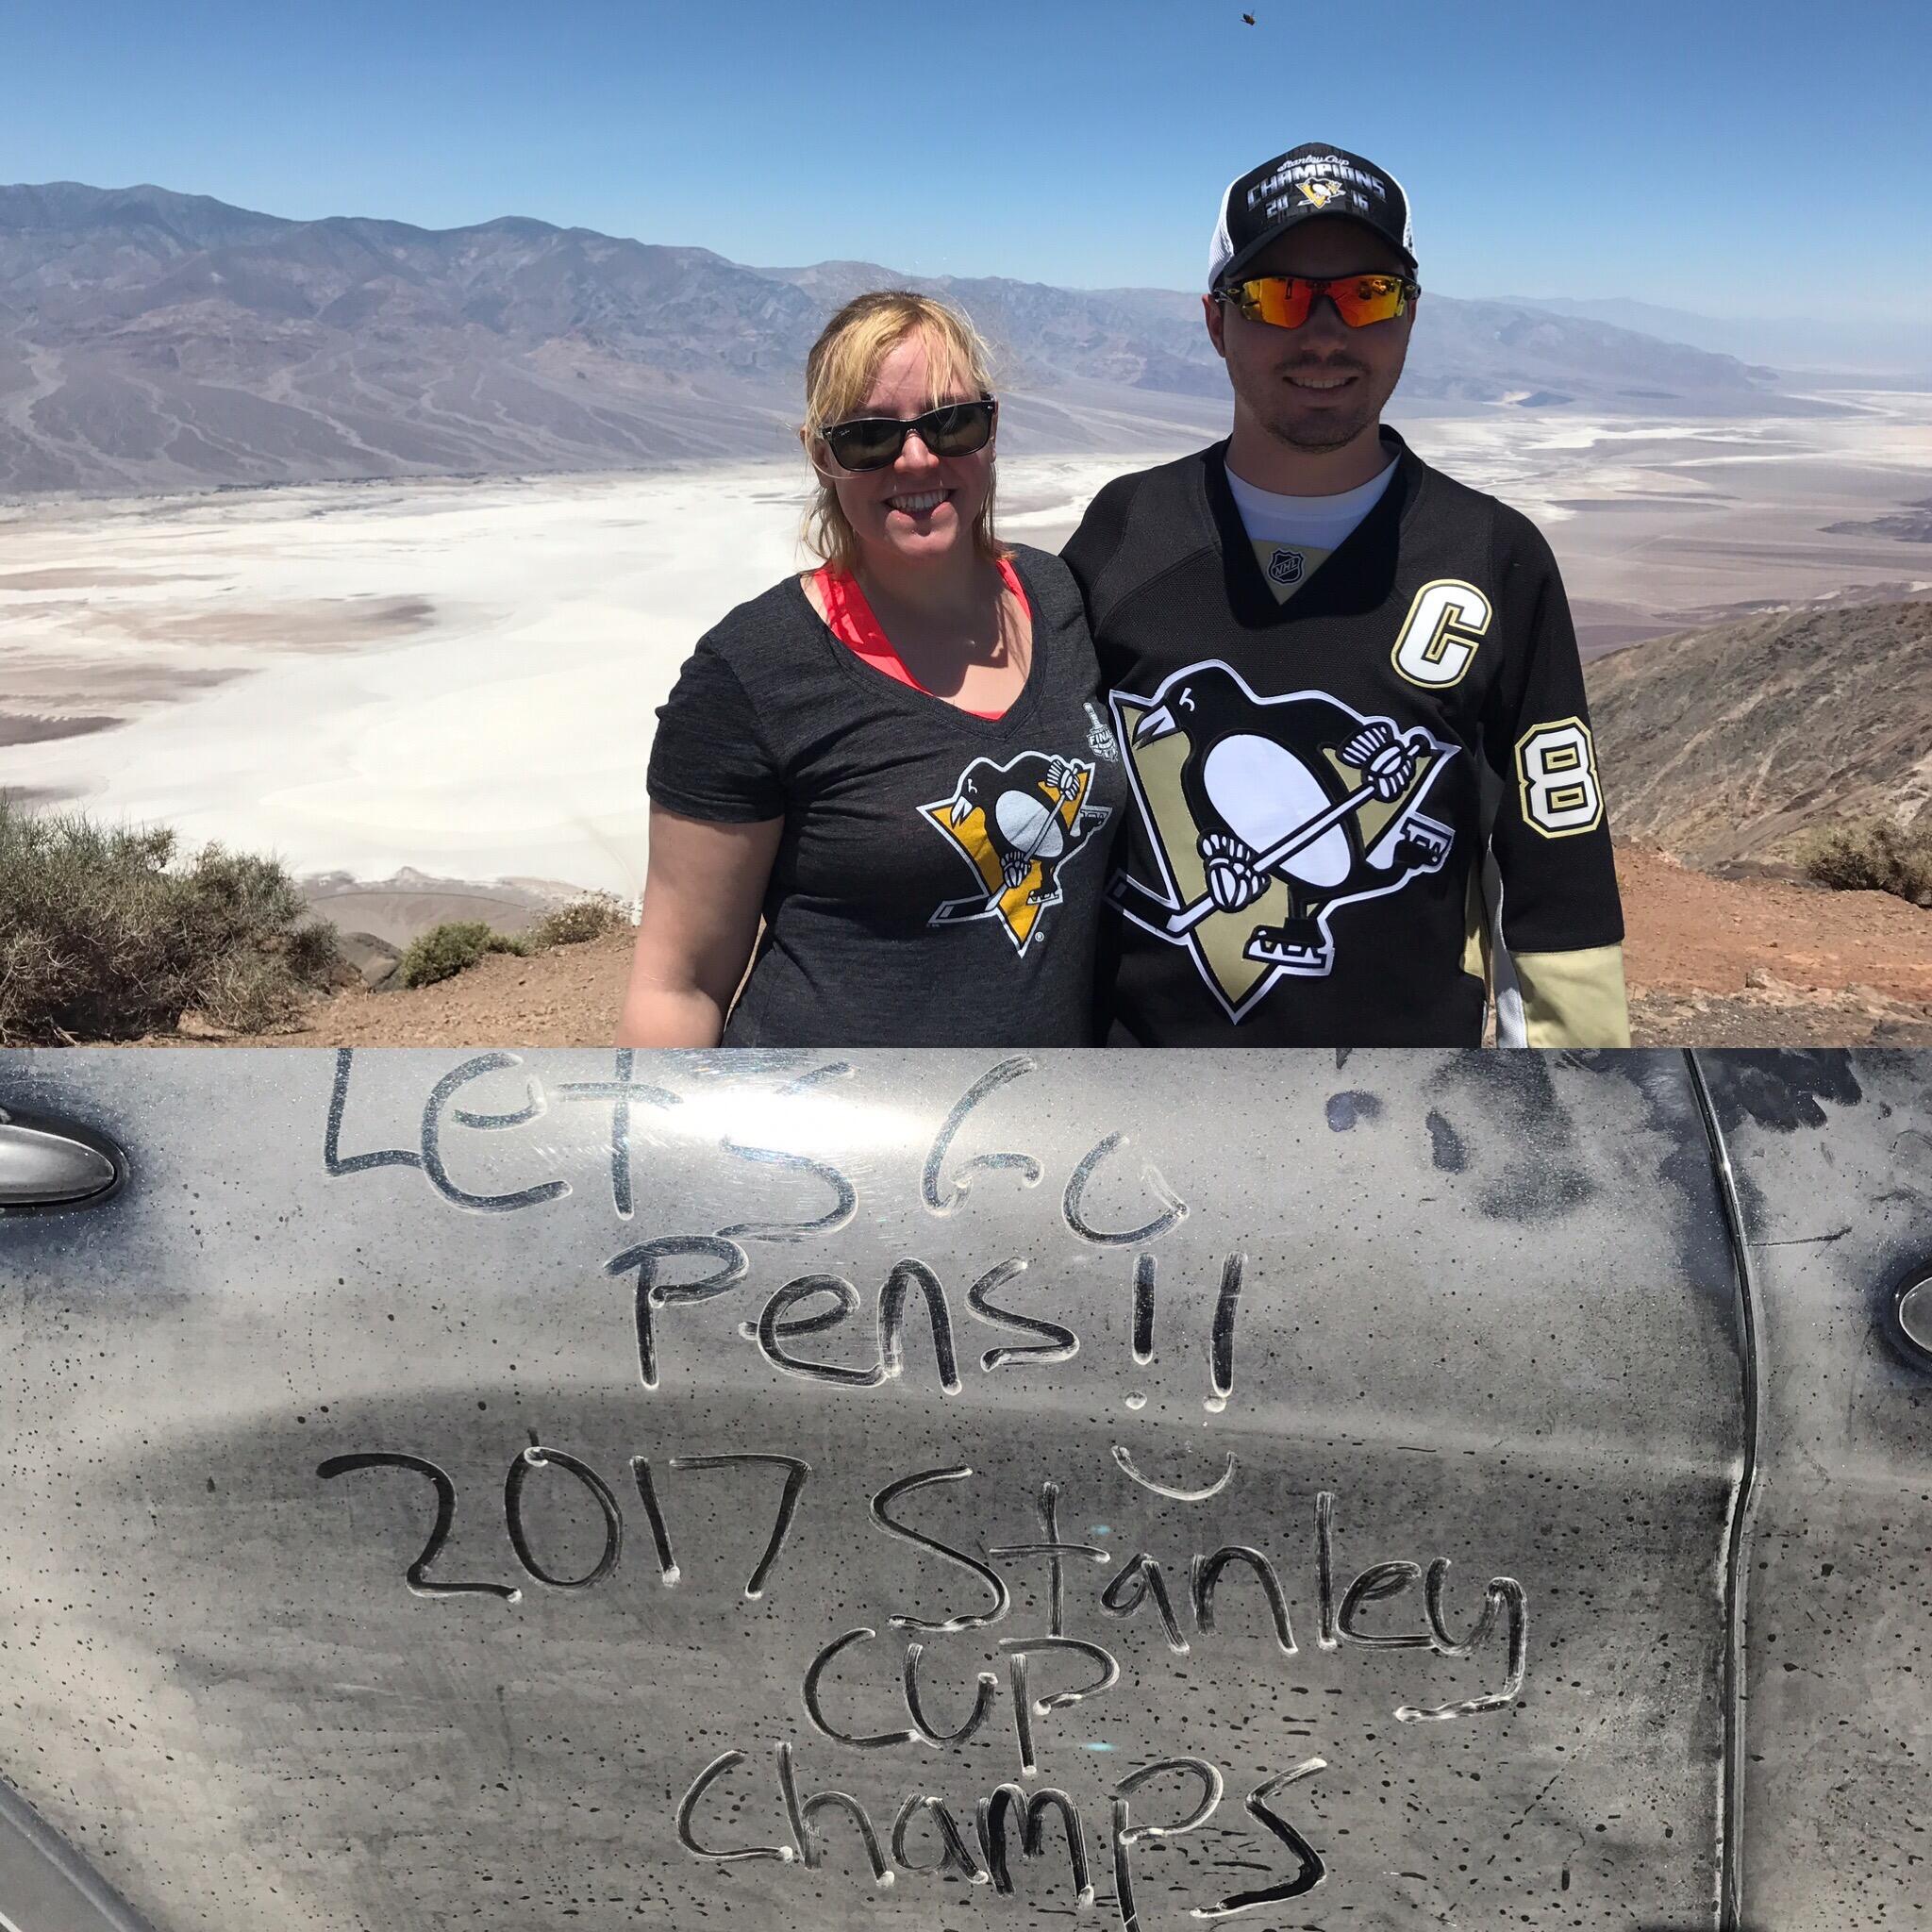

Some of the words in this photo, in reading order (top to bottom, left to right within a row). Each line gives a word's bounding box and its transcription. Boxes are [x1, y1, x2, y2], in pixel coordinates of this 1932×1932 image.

[1246, 162, 1387, 211] CHAMPIONS
[1276, 154, 1323, 173] Stanley
[1323, 155, 1350, 167] Cup
[1274, 558, 1299, 576] NHL
[1391, 578, 1492, 689] C
[1514, 716, 1604, 839] 8
[316, 1428, 812, 1602] 2017
[868, 1463, 1527, 1724] Stanley
